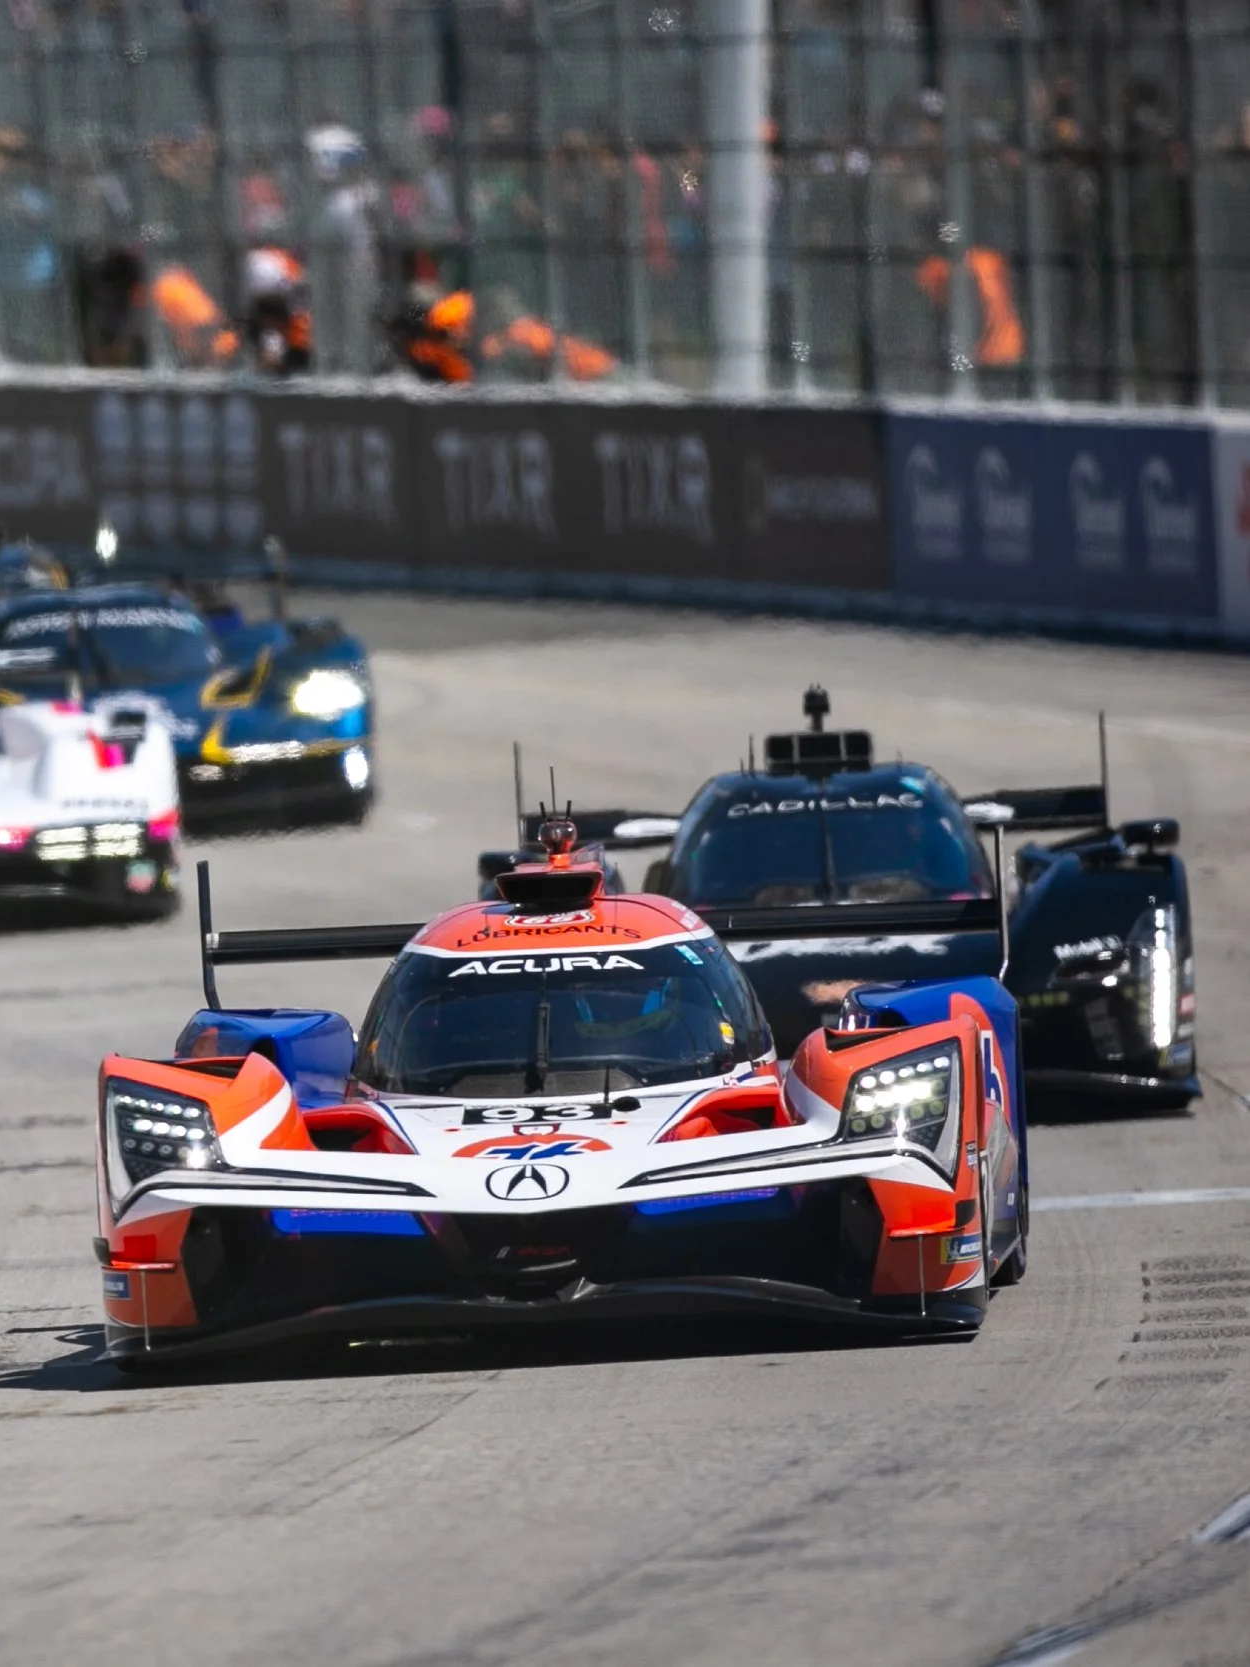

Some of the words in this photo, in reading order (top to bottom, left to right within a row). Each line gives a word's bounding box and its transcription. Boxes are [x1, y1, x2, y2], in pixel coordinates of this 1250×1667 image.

[727, 793, 923, 818] CADILLAC
[457, 924, 641, 948] LUBRICANTS
[447, 955, 645, 978] ACURA
[481, 1104, 594, 1123] 93
